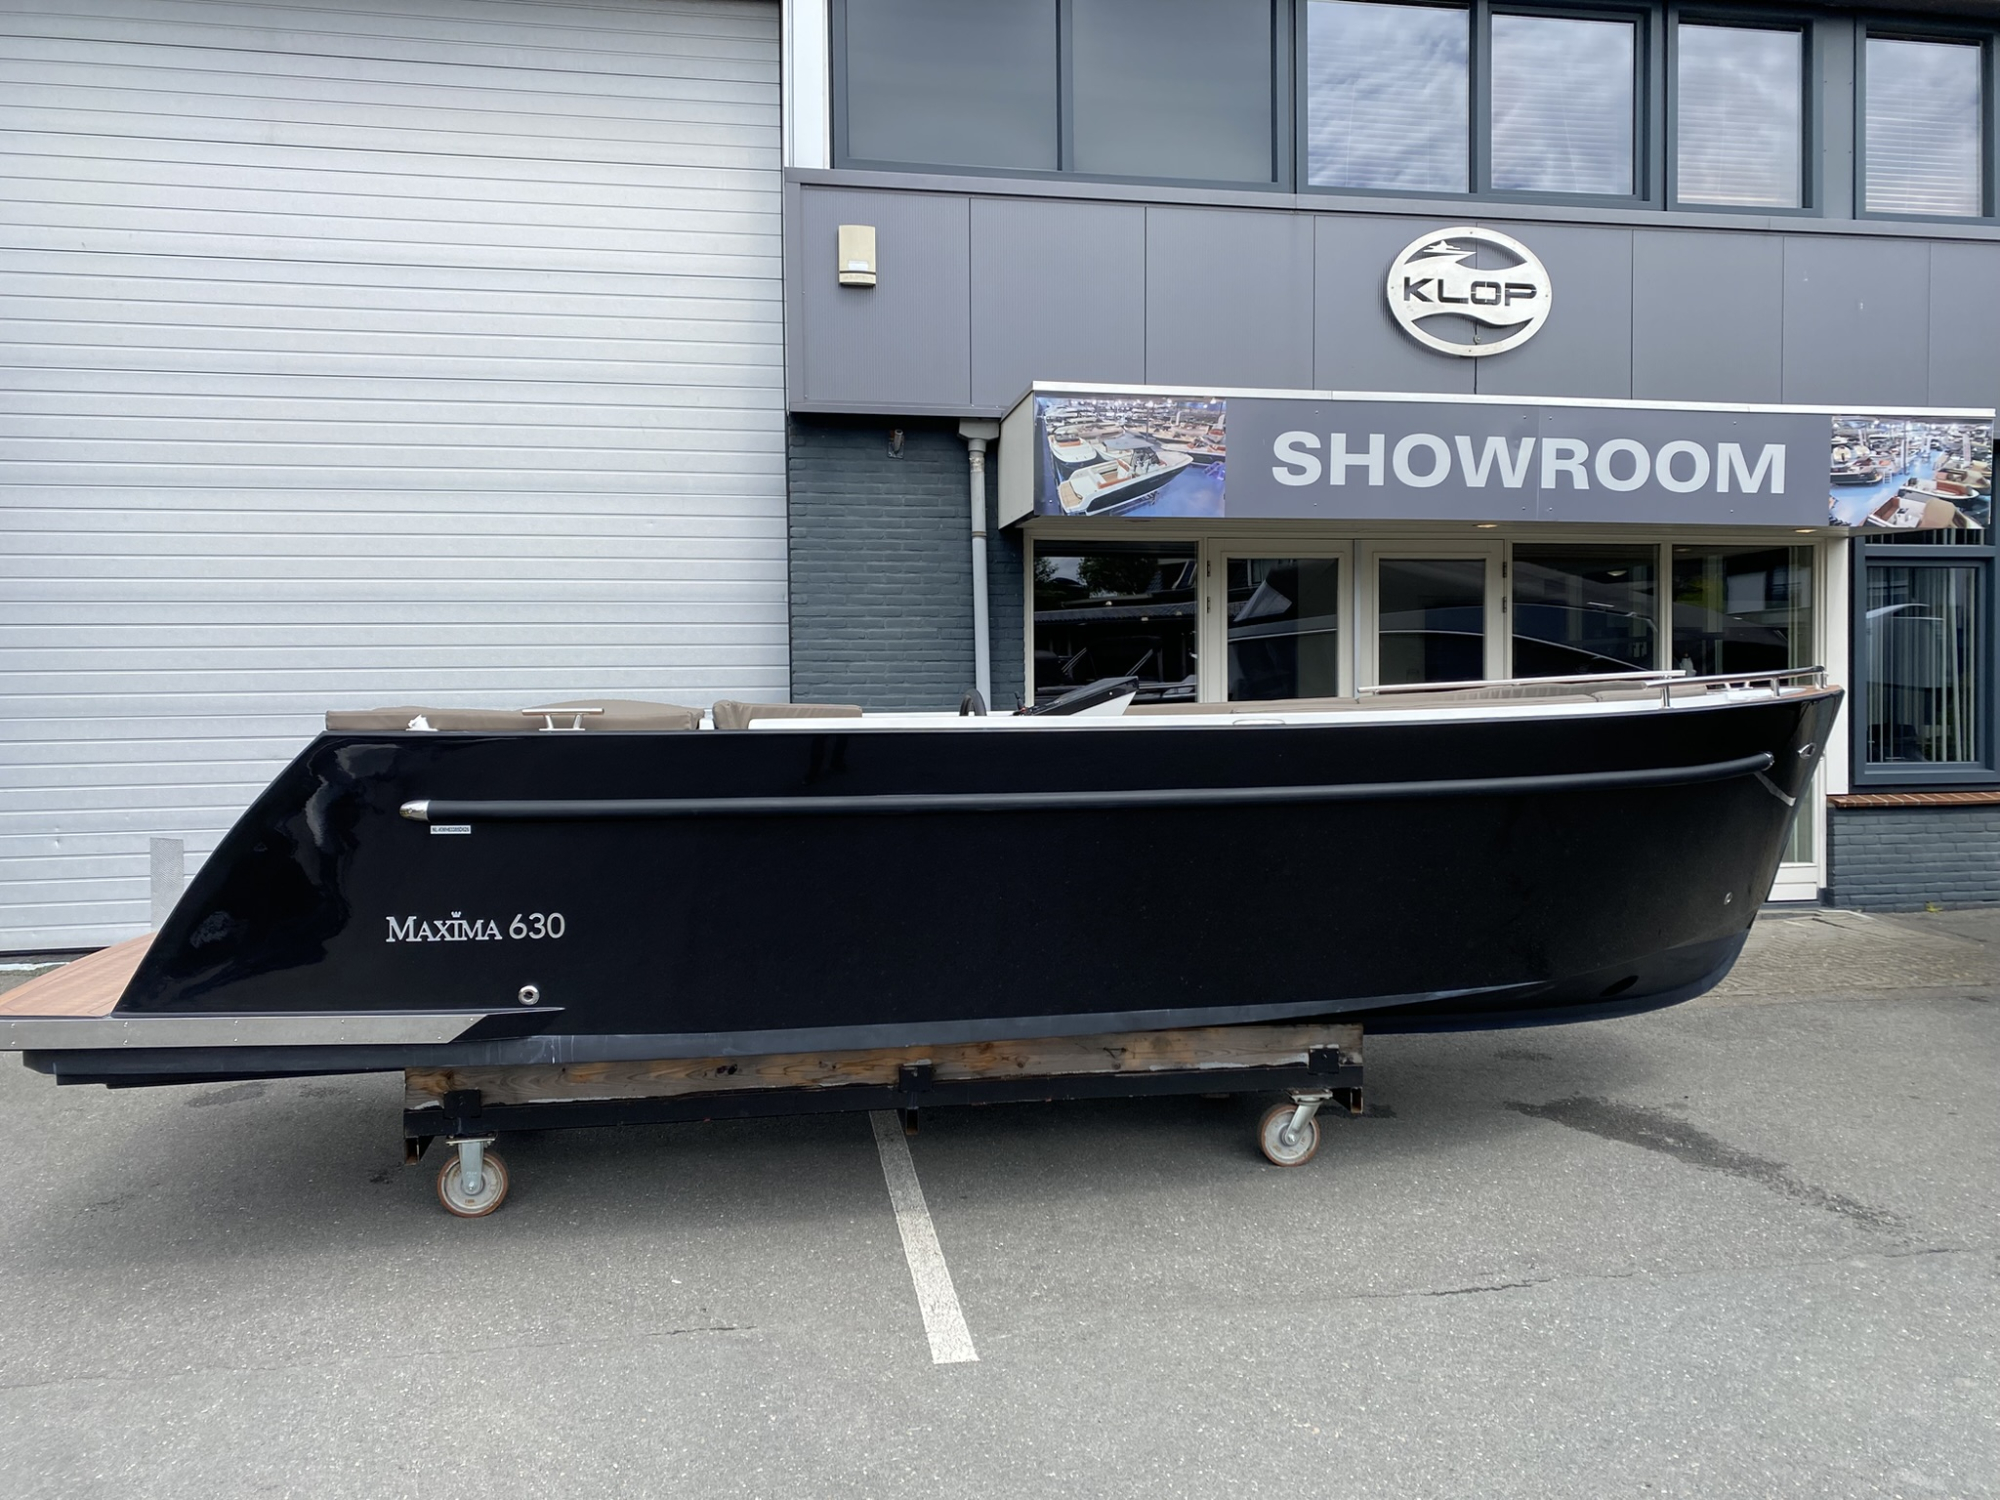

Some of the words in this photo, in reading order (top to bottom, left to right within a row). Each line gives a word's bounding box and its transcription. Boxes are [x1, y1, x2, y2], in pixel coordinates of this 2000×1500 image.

[1403, 276, 1538, 307] KLOP
[1271, 430, 1787, 495] SHOWROOM
[385, 914, 503, 943] MAXIMA
[508, 912, 566, 940] 630
